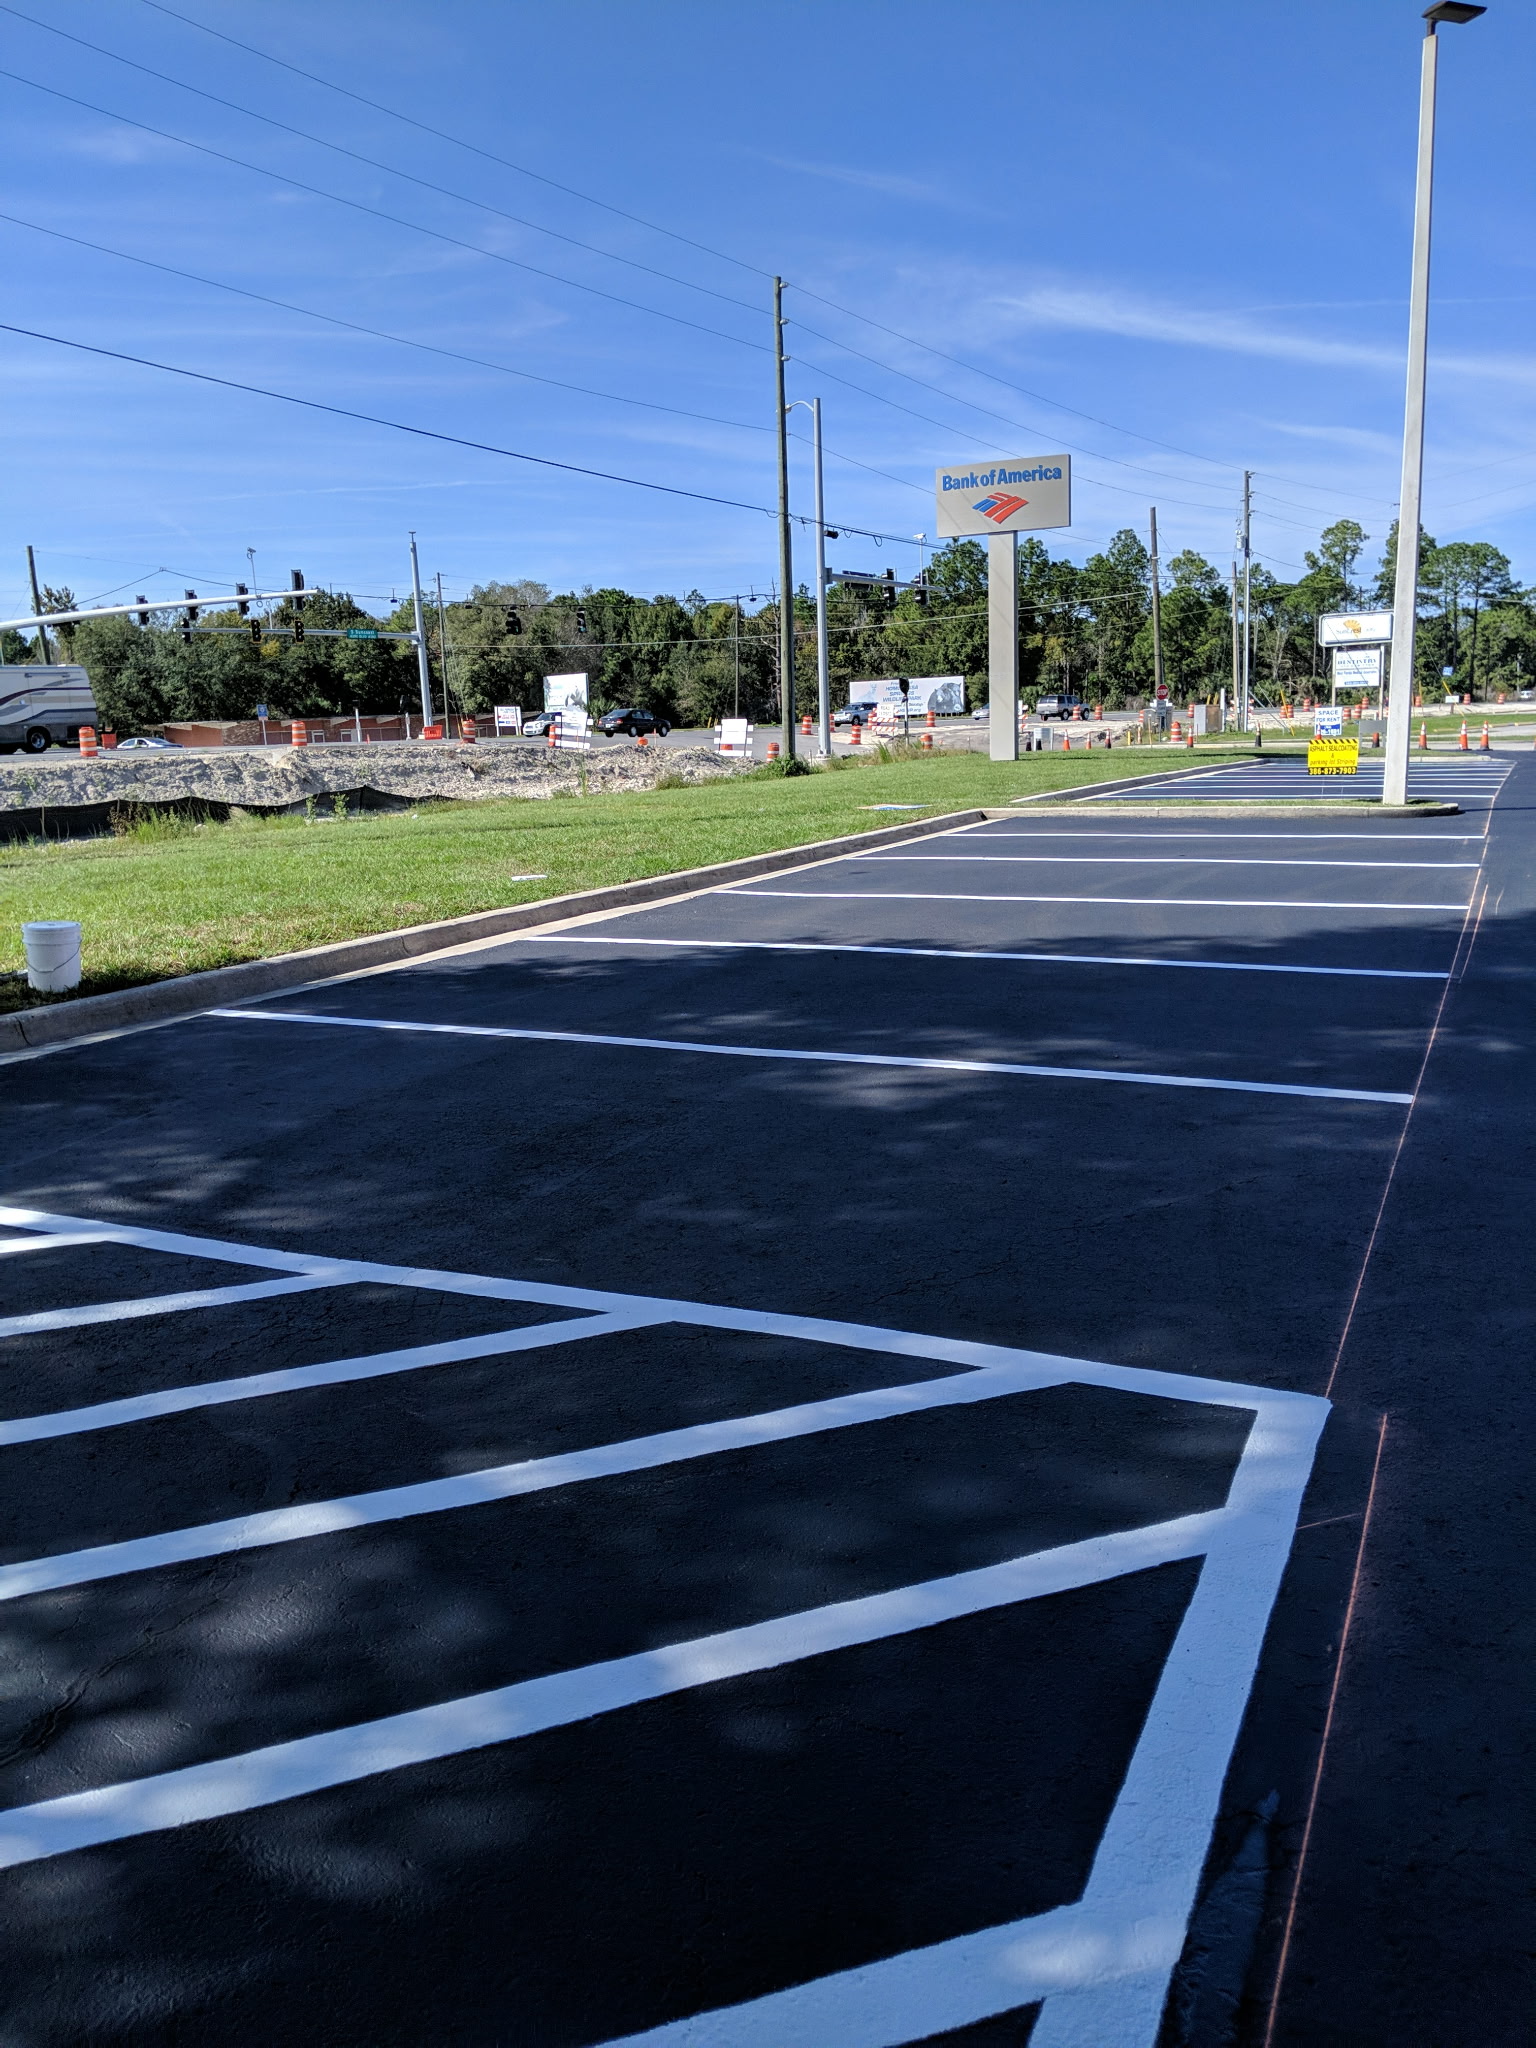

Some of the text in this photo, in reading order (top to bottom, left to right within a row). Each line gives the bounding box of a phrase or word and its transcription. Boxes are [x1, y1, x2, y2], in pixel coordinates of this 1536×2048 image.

[942, 465, 1062, 491] Bank of America
[1328, 744, 1358, 752] SEALCOATING
[1309, 767, 1356, 775] 386-873-7903
